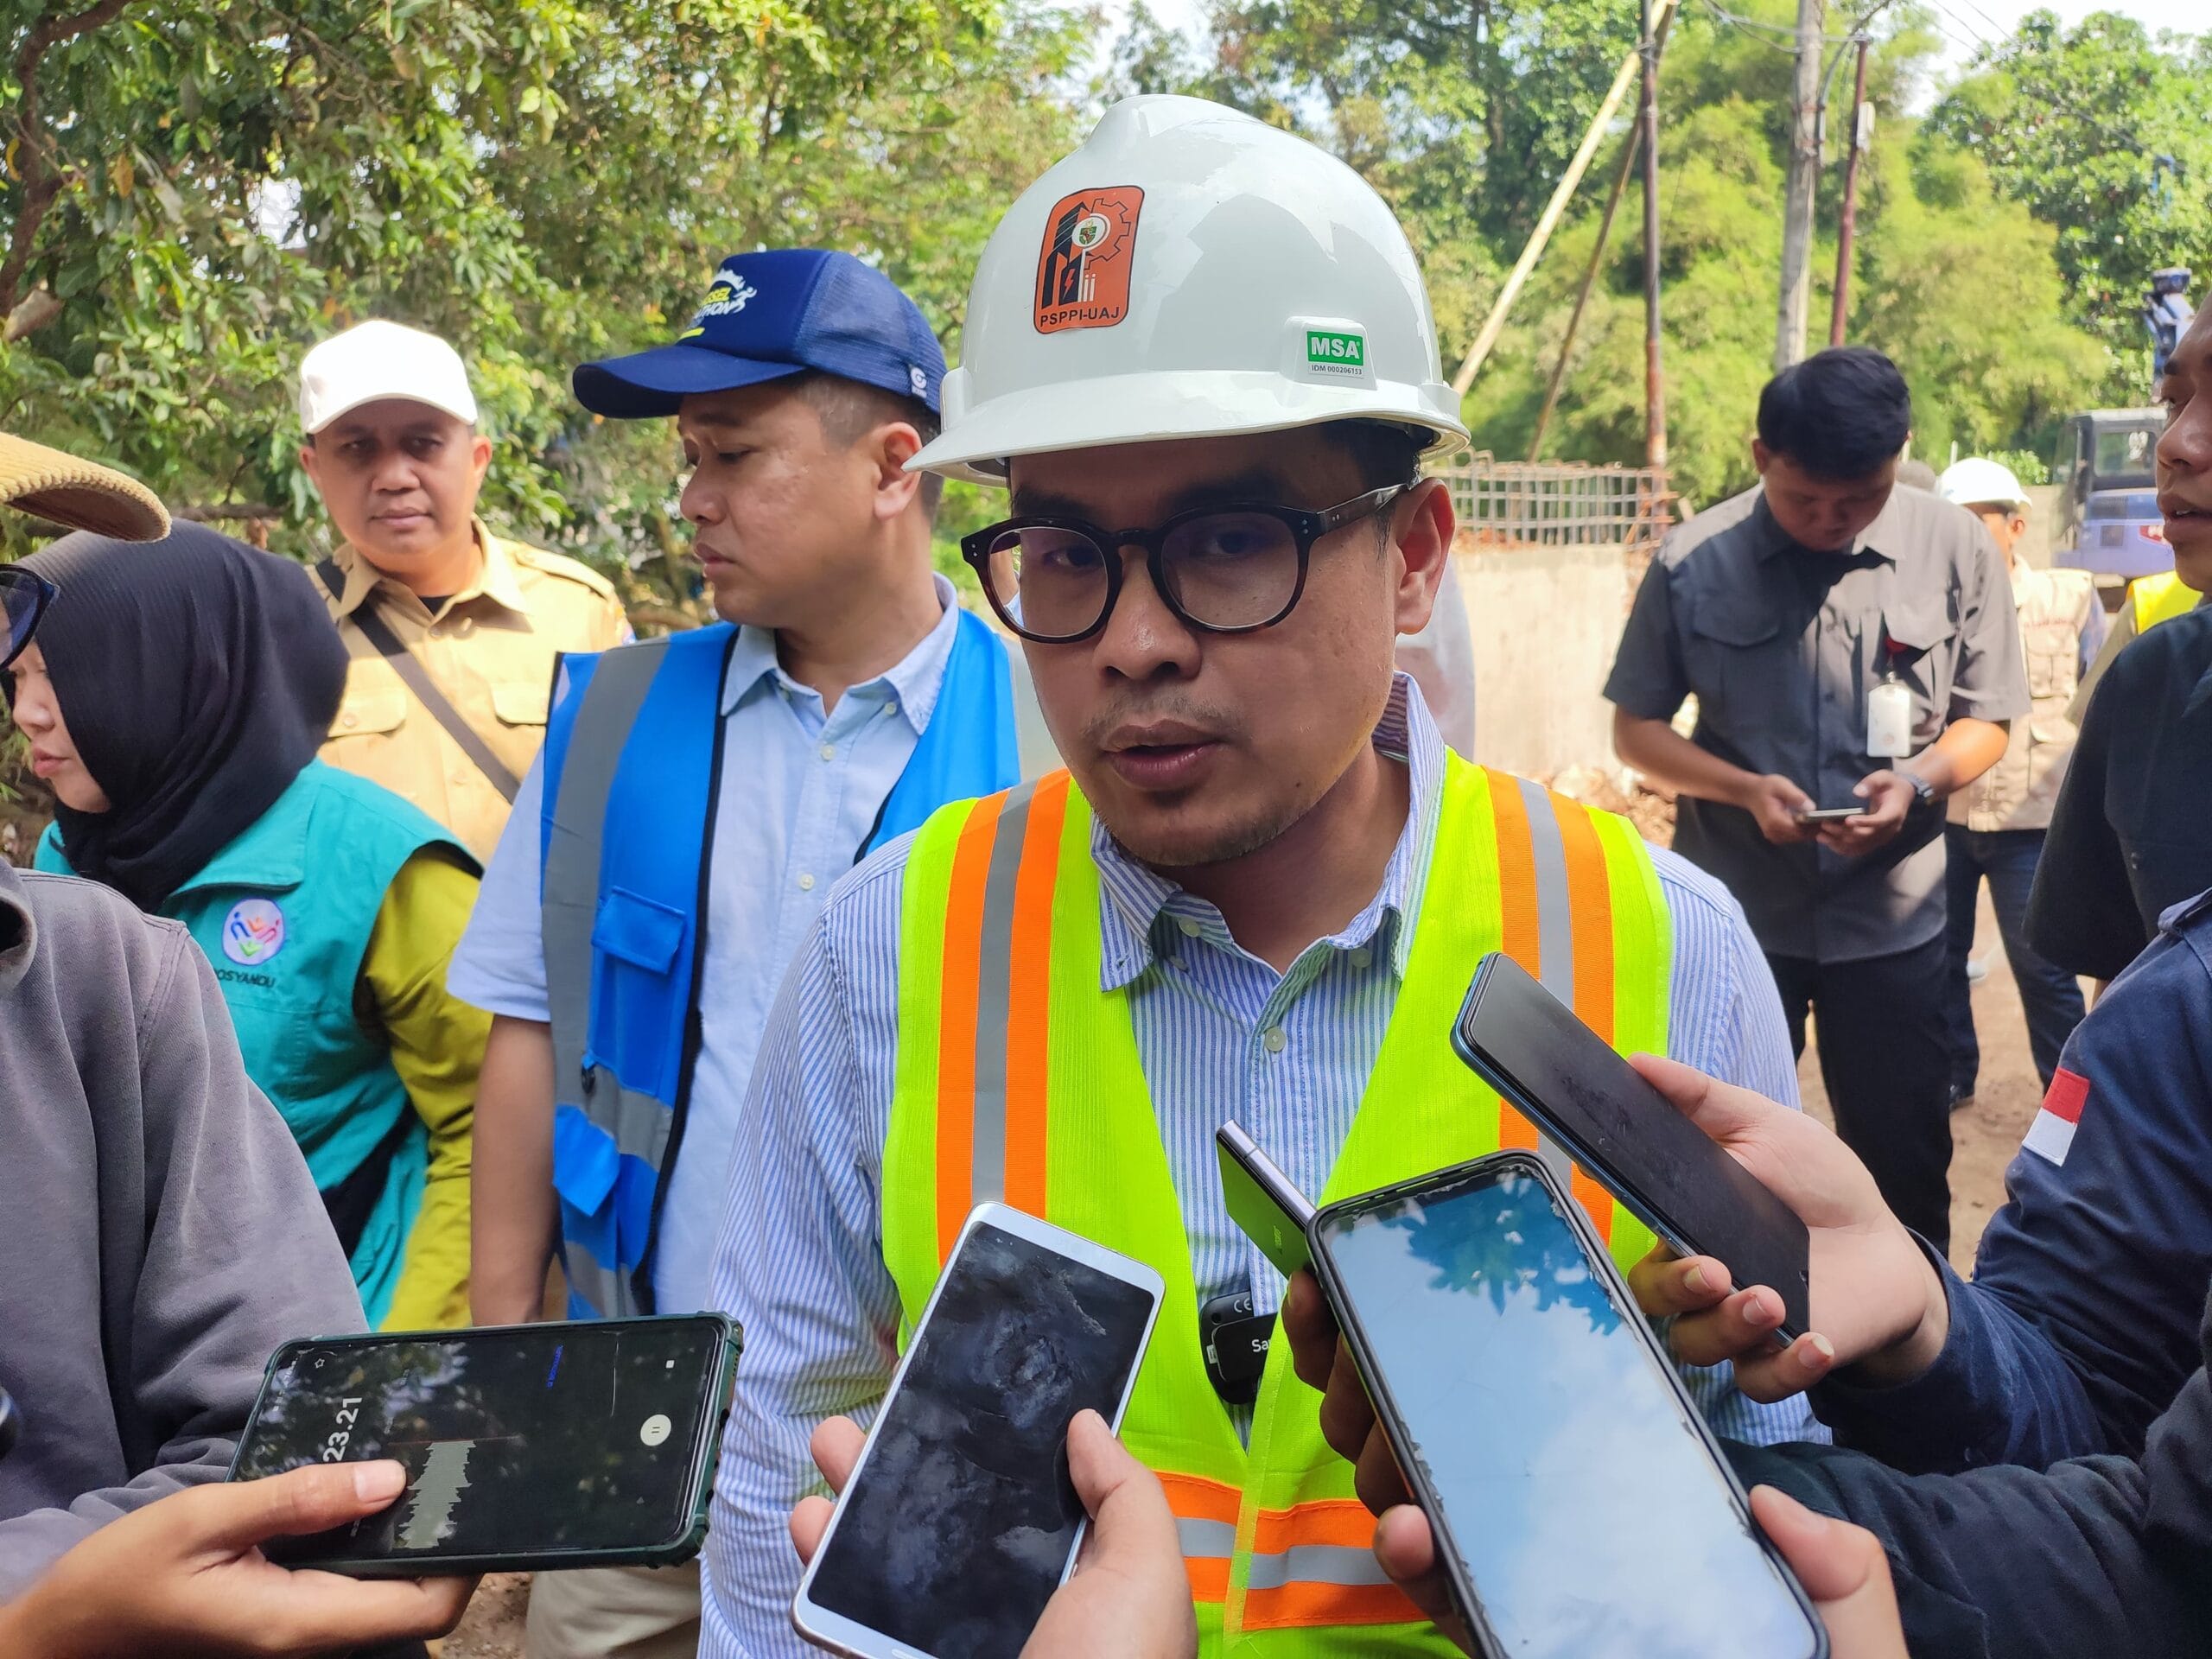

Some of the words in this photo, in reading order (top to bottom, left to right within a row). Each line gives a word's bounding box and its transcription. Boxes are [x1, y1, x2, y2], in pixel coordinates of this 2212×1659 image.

[1039, 306, 1121, 327] PSPPI-UAJ
[1311, 336, 1360, 359] MSA
[1312, 364, 1326, 372] IDM
[213, 969, 276, 988] OSYANDU
[1233, 1298, 1252, 1313] CE
[1251, 1338, 1271, 1353] Sa
